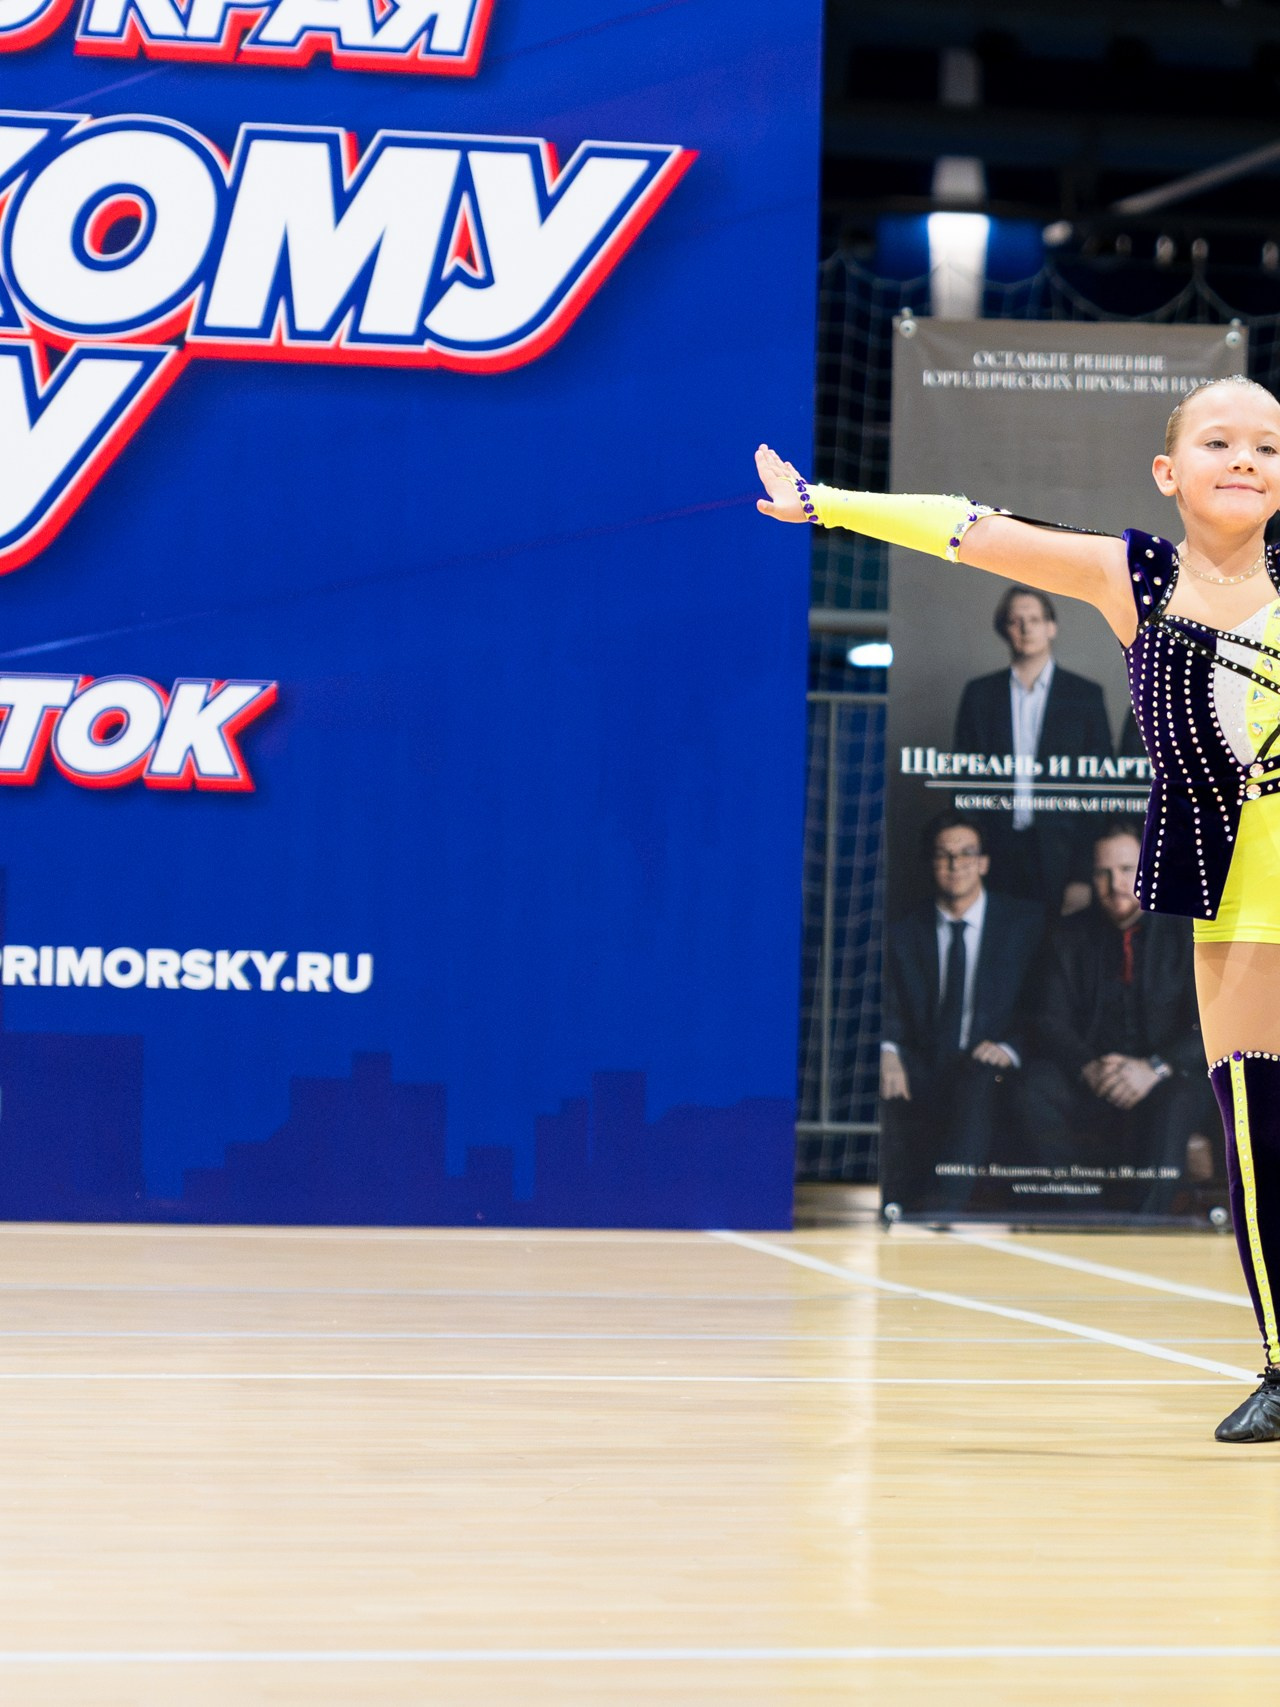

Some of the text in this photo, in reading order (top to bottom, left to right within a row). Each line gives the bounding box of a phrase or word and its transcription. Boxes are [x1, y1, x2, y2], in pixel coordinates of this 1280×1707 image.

[1170, 375, 1213, 394] НА
[900, 746, 1044, 778] ЩЕРБАНЬ
[1049, 754, 1070, 777] И
[0, 945, 374, 993] RIMORSKY.RU
